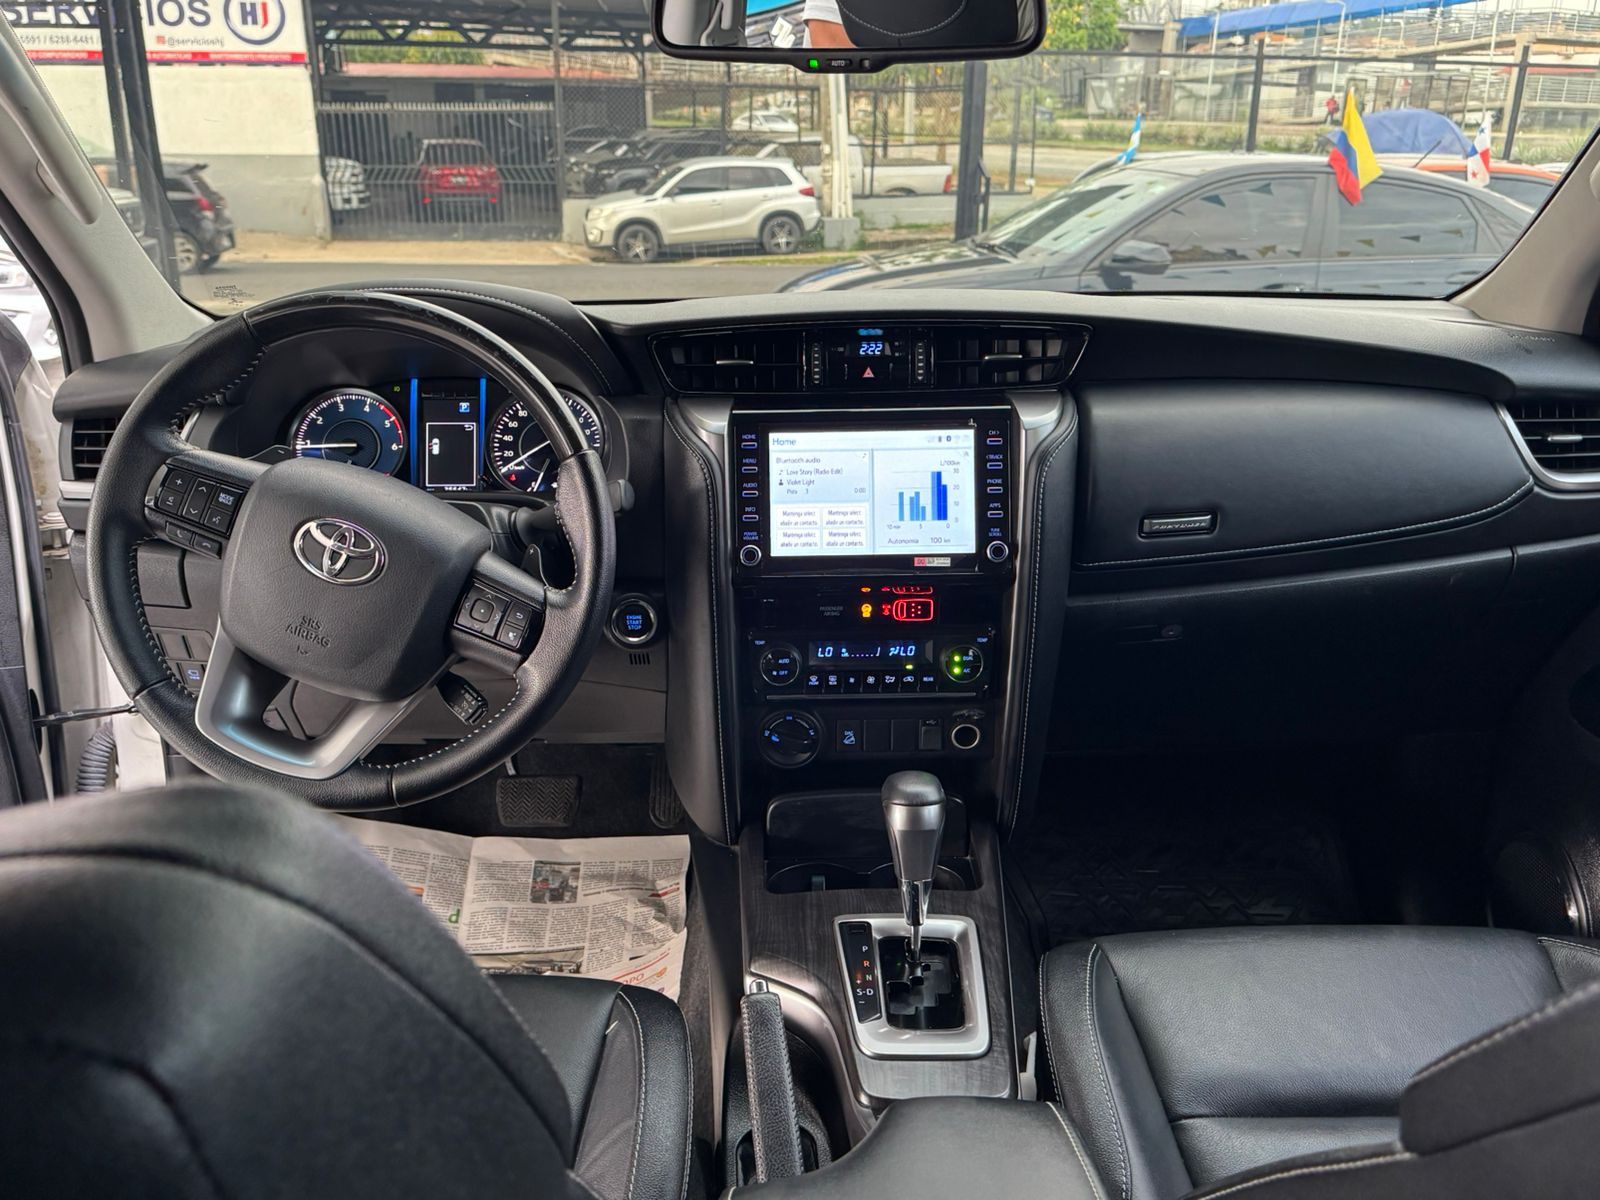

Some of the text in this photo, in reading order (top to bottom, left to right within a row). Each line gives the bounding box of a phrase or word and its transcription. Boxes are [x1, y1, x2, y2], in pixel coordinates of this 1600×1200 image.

[240, 2, 269, 29] HJ
[859, 343, 883, 355] 2:22
[338, 404, 345, 412] 3
[363, 404, 370, 412] 4
[316, 416, 323, 425] 2
[384, 419, 391, 428] 5
[391, 443, 398, 451] 6
[772, 438, 797, 446] Home
[301, 616, 321, 630] SRS
[285, 623, 331, 648] AIRBAG
[817, 646, 834, 657] LO
[900, 645, 916, 656] LO
